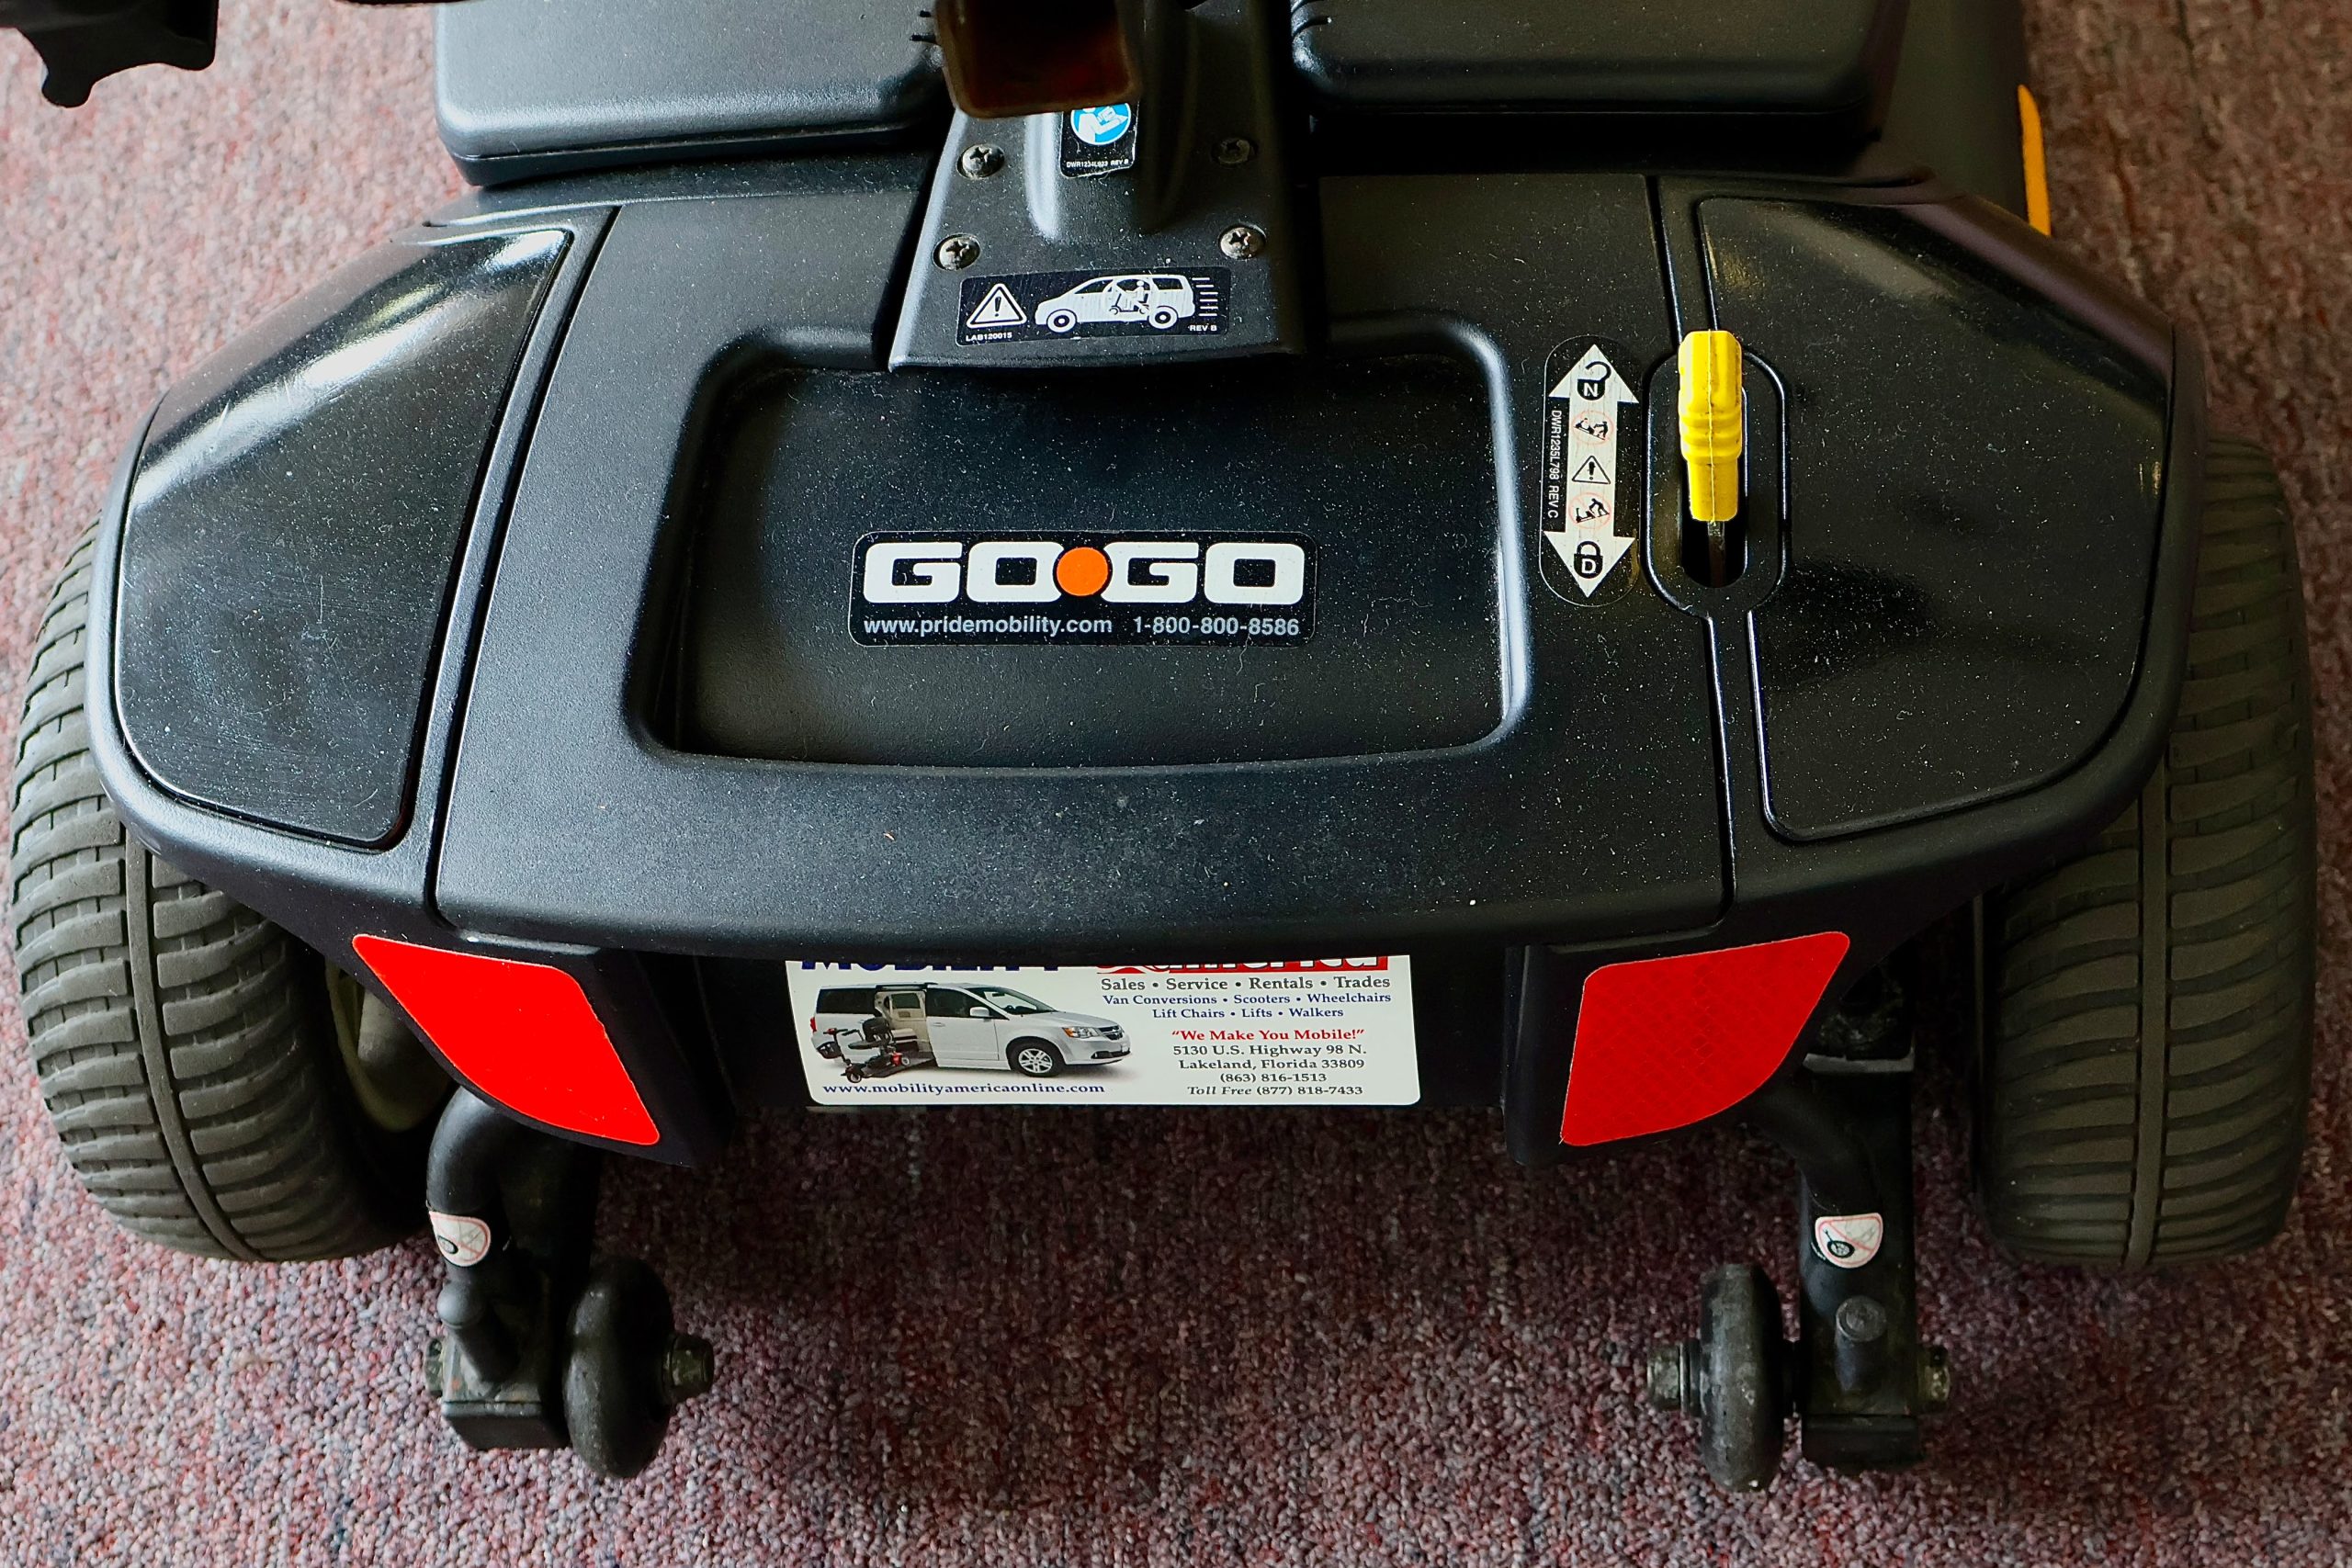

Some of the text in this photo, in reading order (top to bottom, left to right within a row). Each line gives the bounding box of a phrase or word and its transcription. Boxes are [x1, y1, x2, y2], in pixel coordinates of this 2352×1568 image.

[966, 332, 1012, 342] LAB120015
[1583, 382, 1598, 397] N
[1547, 410, 1562, 519] DWR1235L798 REV C
[1581, 558, 1597, 573] D
[864, 615, 1299, 637] www.pridemobility.com 1-800-800-8586
[1101, 976, 1391, 991] Sales Service Rentals Trades
[1102, 992, 1392, 1006] Van Conversions Scooters Wheelchairs
[1152, 1007, 1344, 1019] Lift Chairs Lifts Walkers
[1209, 1030, 1255, 1041] Make
[1259, 1029, 1290, 1041] You
[1172, 1043, 1367, 1057] 5130 U.S. Highway 98 N.
[1179, 1058, 1365, 1071] Lakeland, Florida 33809
[1220, 1073, 1328, 1083] (863) 816-1513
[822, 1082, 1106, 1096] www.mobilityamericaonline.com
[1187, 1086, 1364, 1096] Toll Free (877) 818-7433
